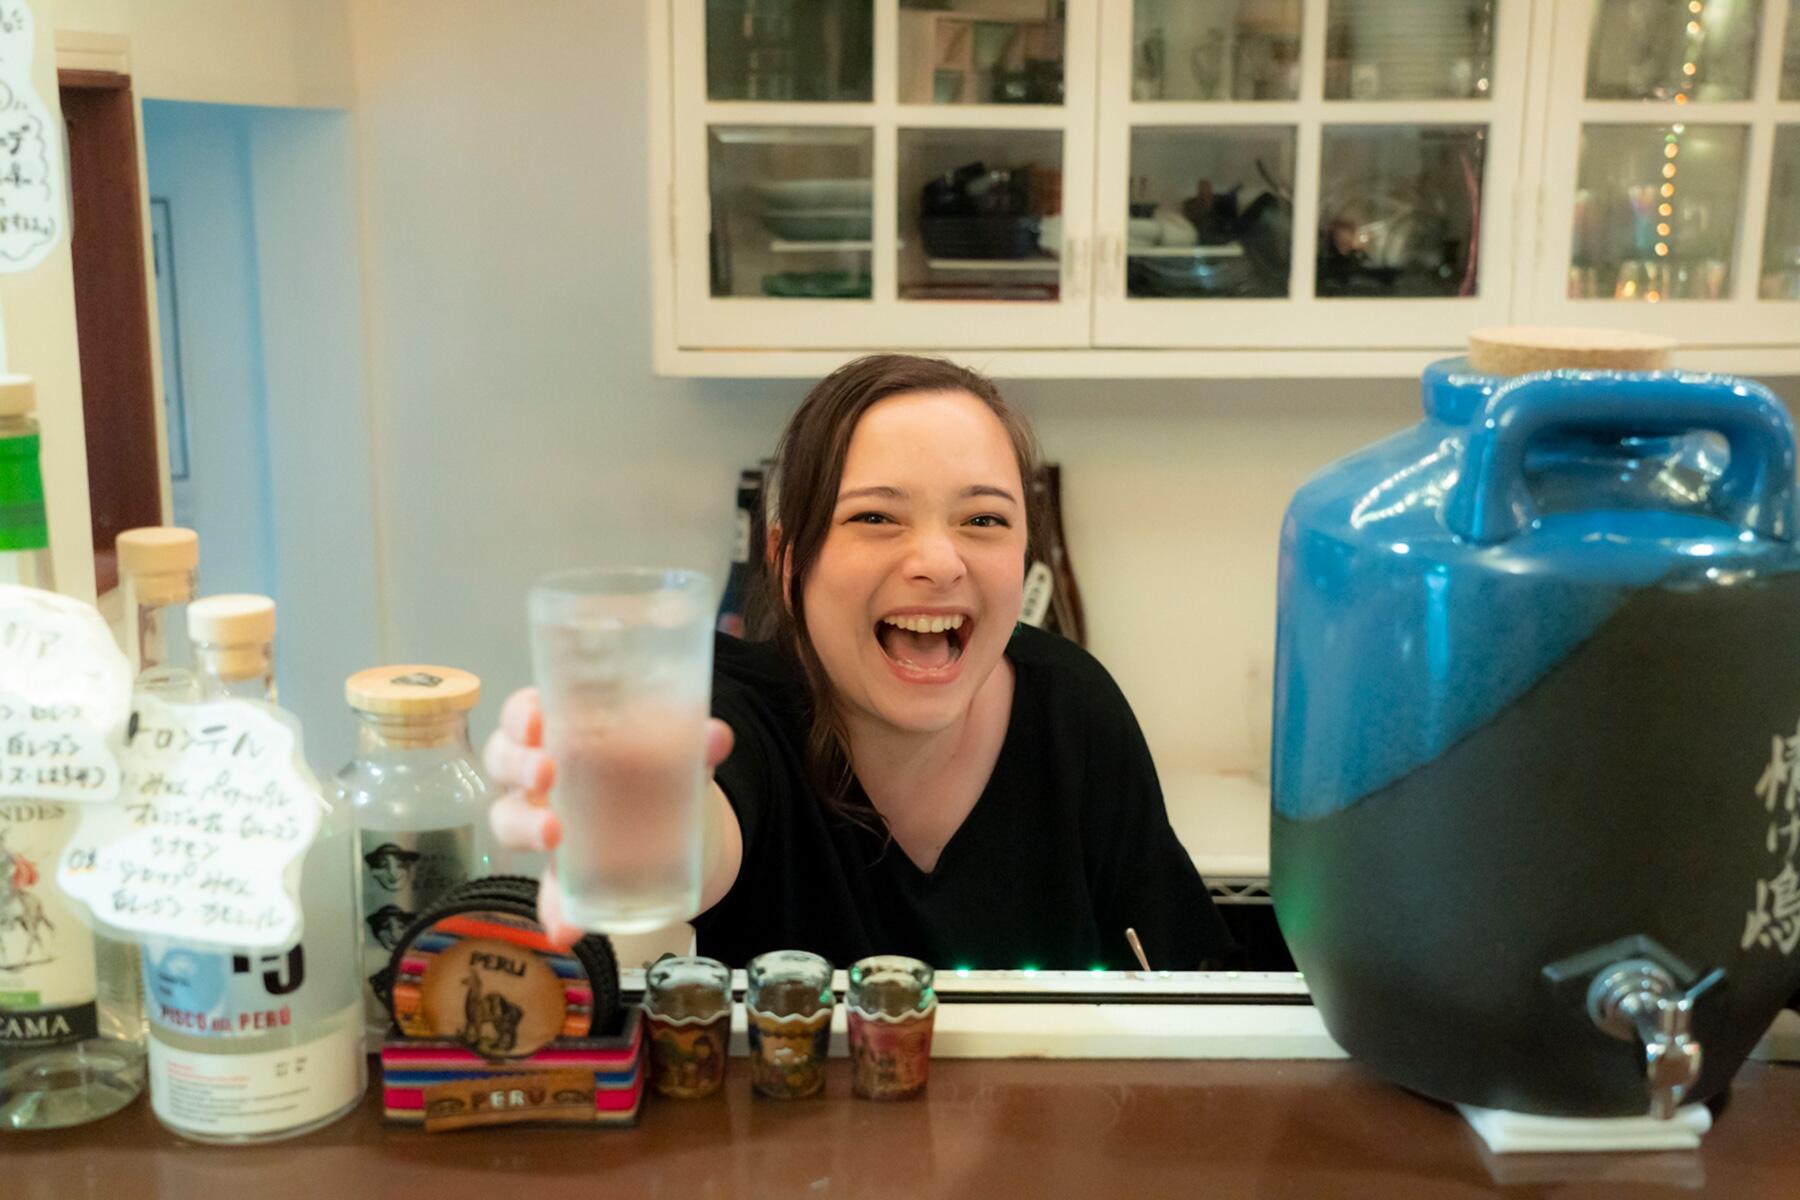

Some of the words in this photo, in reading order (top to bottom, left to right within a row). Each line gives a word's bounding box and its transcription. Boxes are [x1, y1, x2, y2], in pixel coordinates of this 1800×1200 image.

[469, 951, 528, 978] PERU
[159, 1003, 208, 1031] PISCO
[470, 1086, 546, 1110] PERU
